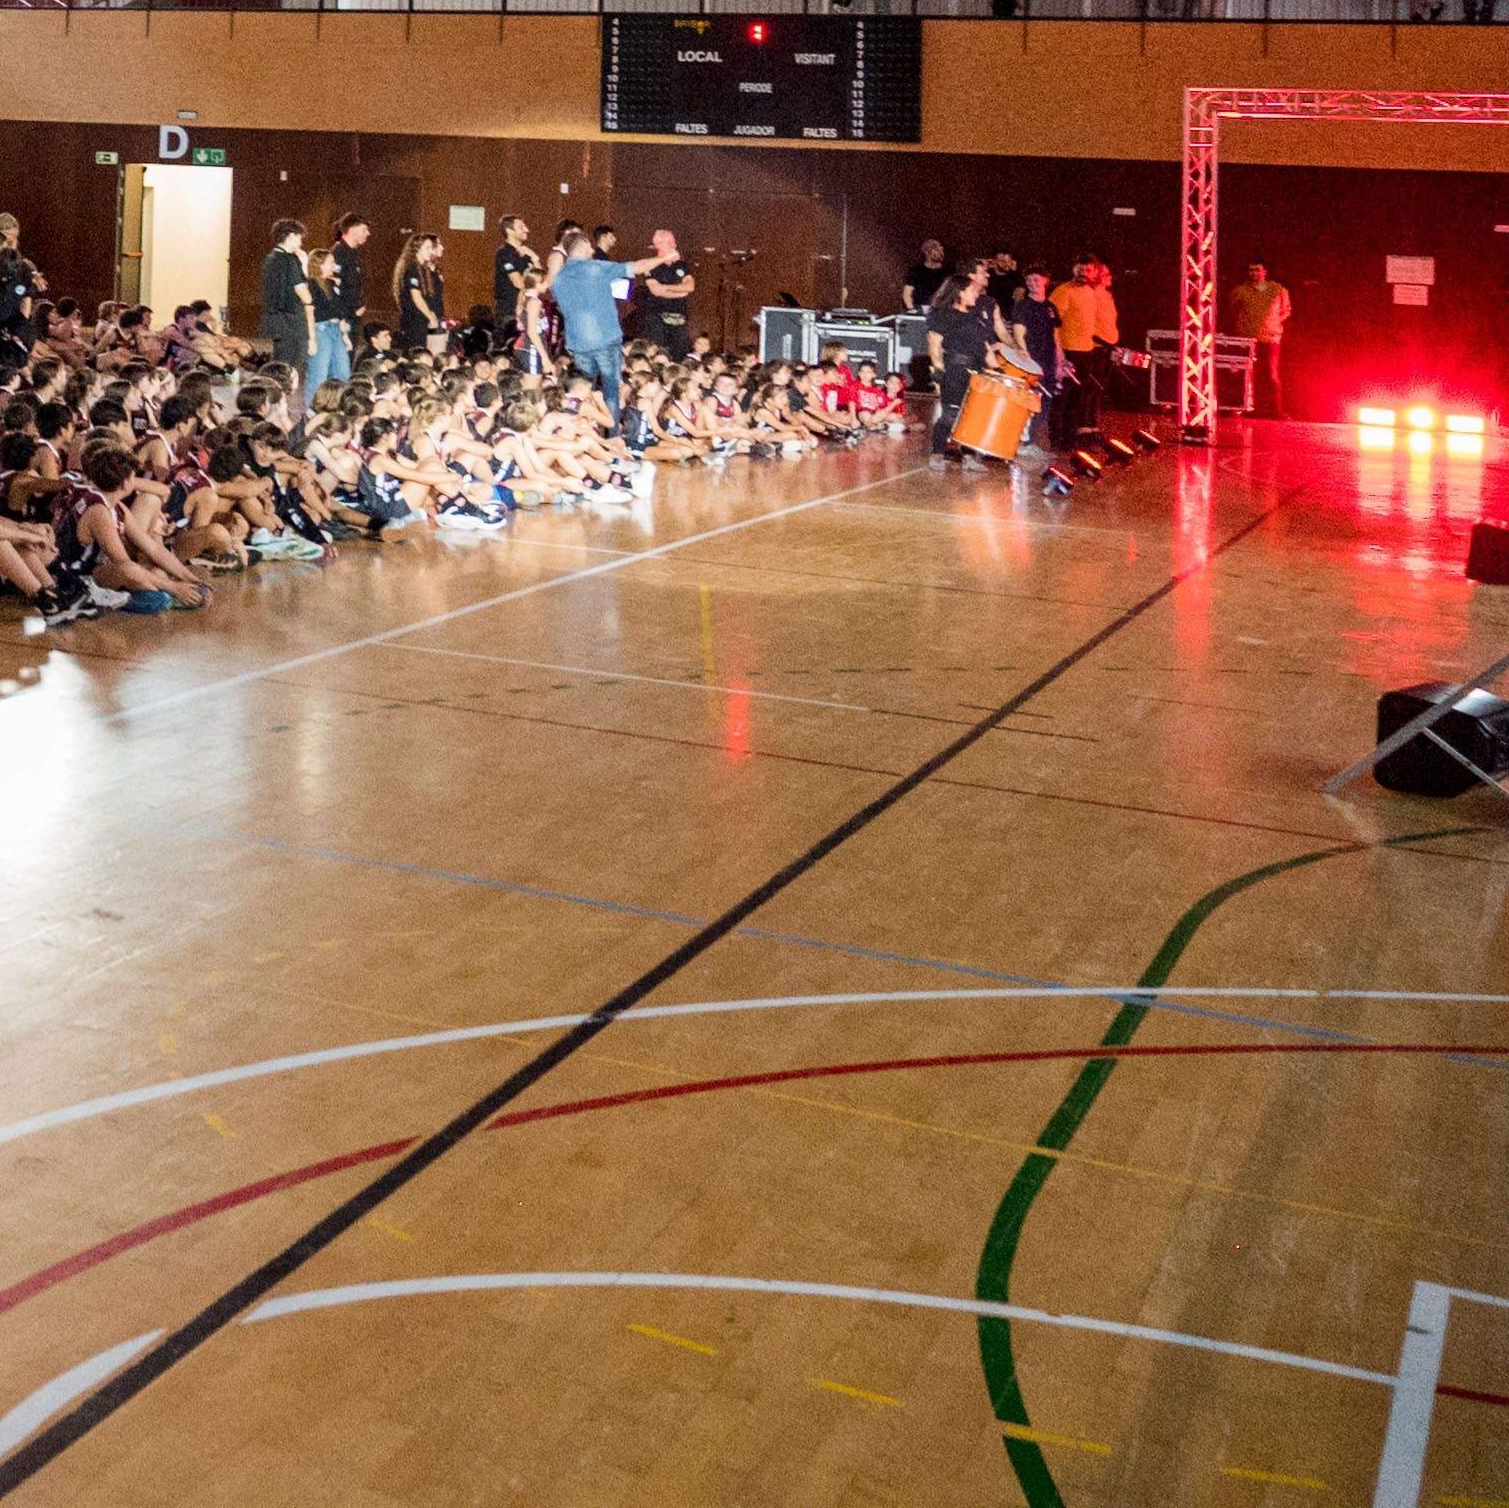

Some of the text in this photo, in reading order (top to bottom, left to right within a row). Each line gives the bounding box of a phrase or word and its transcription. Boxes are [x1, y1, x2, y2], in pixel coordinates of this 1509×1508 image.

[677, 50, 723, 63] LOCAL
[794, 52, 836, 65] VISITANT
[674, 123, 709, 134] FALTES
[733, 125, 775, 136] JUGADOR
[803, 127, 838, 138] FALTES
[159, 125, 189, 159] D
